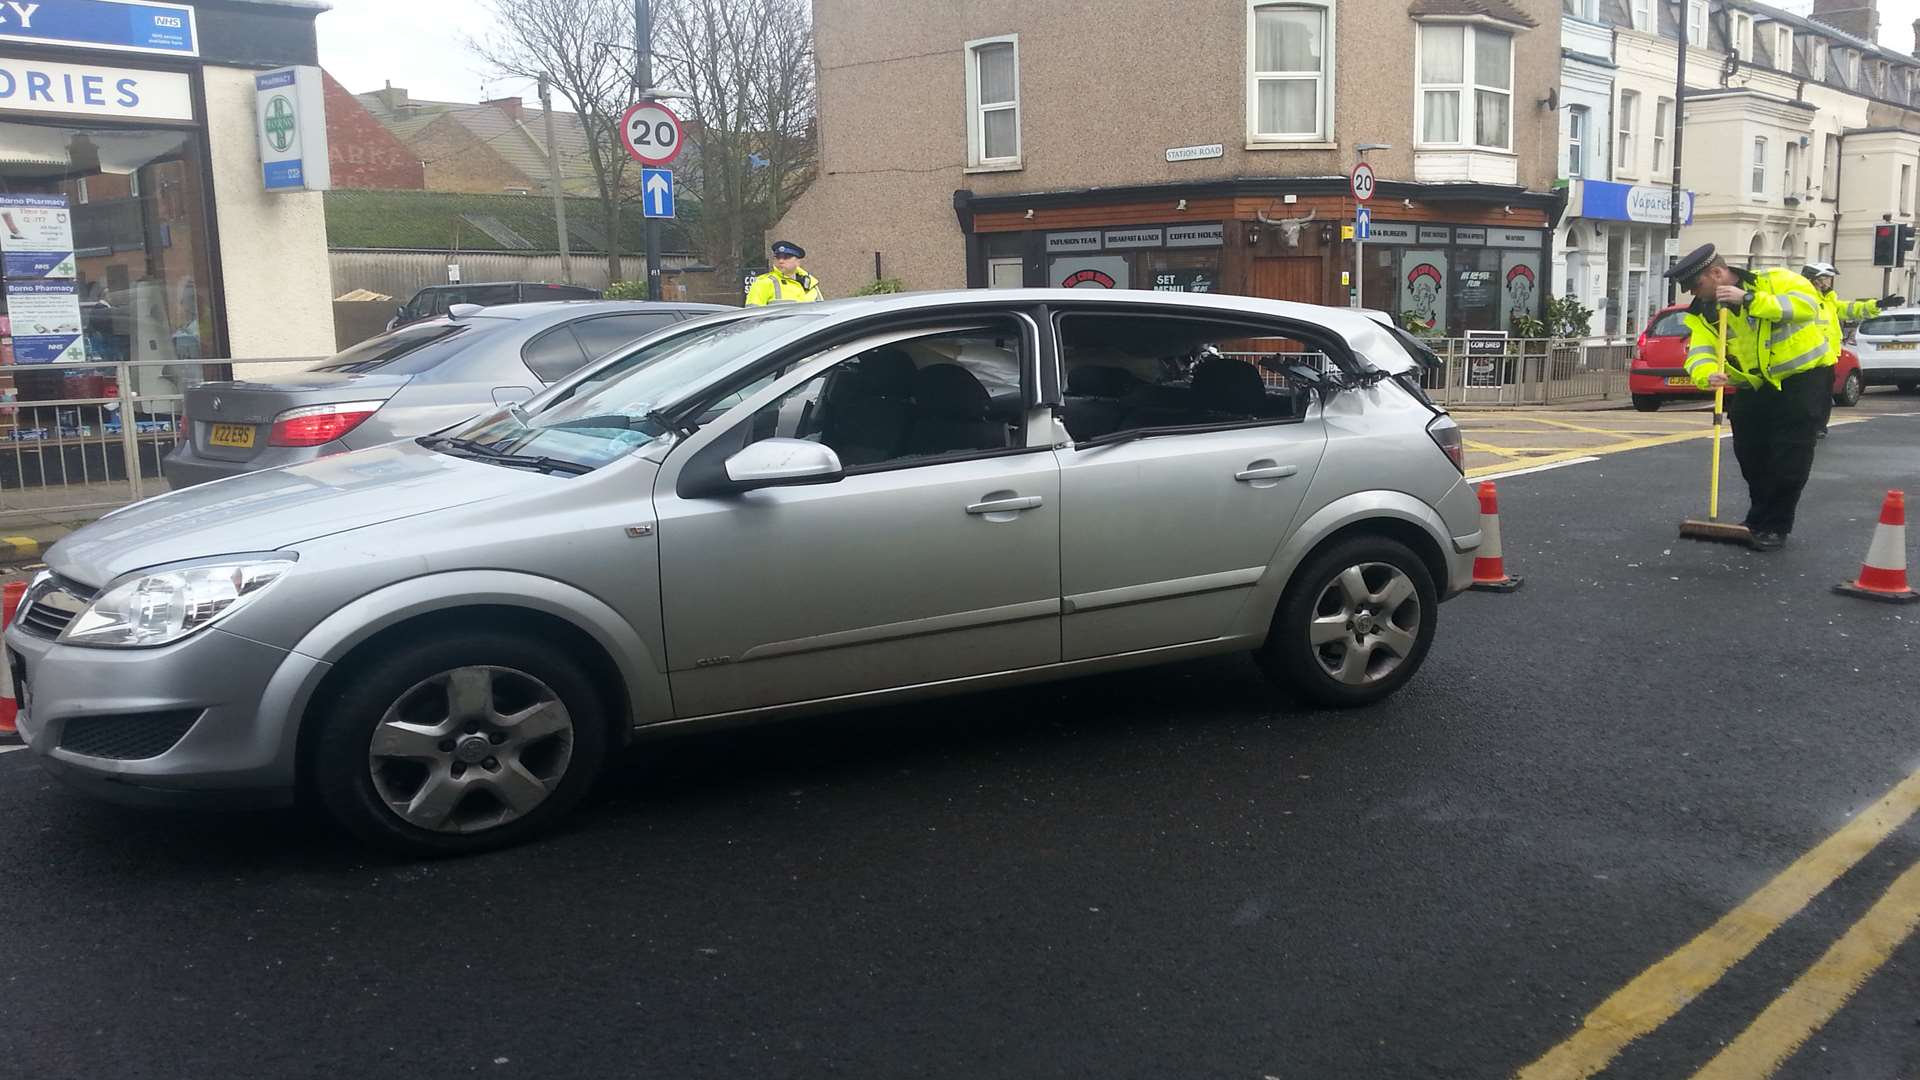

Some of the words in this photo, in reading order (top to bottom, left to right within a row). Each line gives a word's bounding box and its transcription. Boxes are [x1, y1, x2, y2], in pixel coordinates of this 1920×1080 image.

[0, 1, 39, 28] Y
[156, 16, 179, 26] NHS
[632, 119, 675, 147] 20
[1168, 149, 1197, 159] STATION
[1199, 146, 1221, 156] ROAD
[1355, 174, 1372, 191] 20
[26, 198, 65, 207] Pharmacy
[1169, 232, 1196, 240] COFFEE
[1197, 231, 1223, 239] HOUSE
[1156, 274, 1176, 285] SET
[35, 285, 74, 293] Pharmacy
